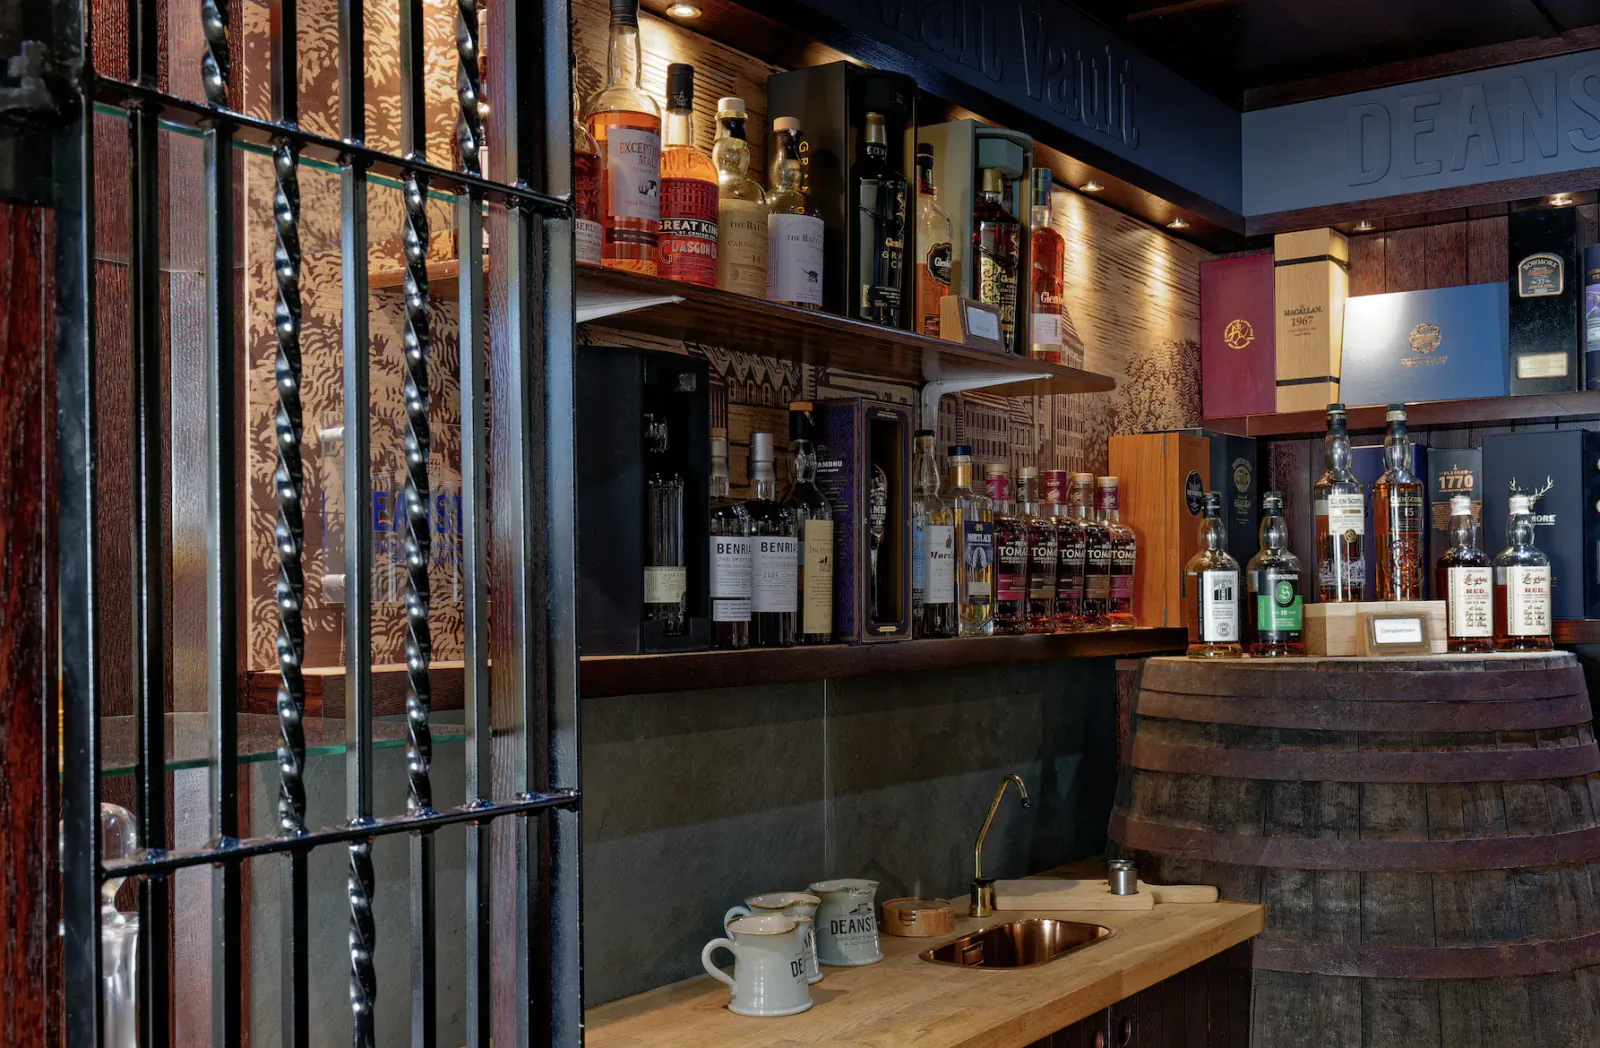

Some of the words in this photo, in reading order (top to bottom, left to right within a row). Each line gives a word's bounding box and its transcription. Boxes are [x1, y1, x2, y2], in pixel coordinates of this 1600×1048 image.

[1018, 2, 1140, 150] Vault
[657, 220, 698, 231] GREAT
[1523, 259, 1558, 270] BOWMORE
[1291, 316, 1314, 327] 1967
[1439, 475, 1474, 489] 1770
